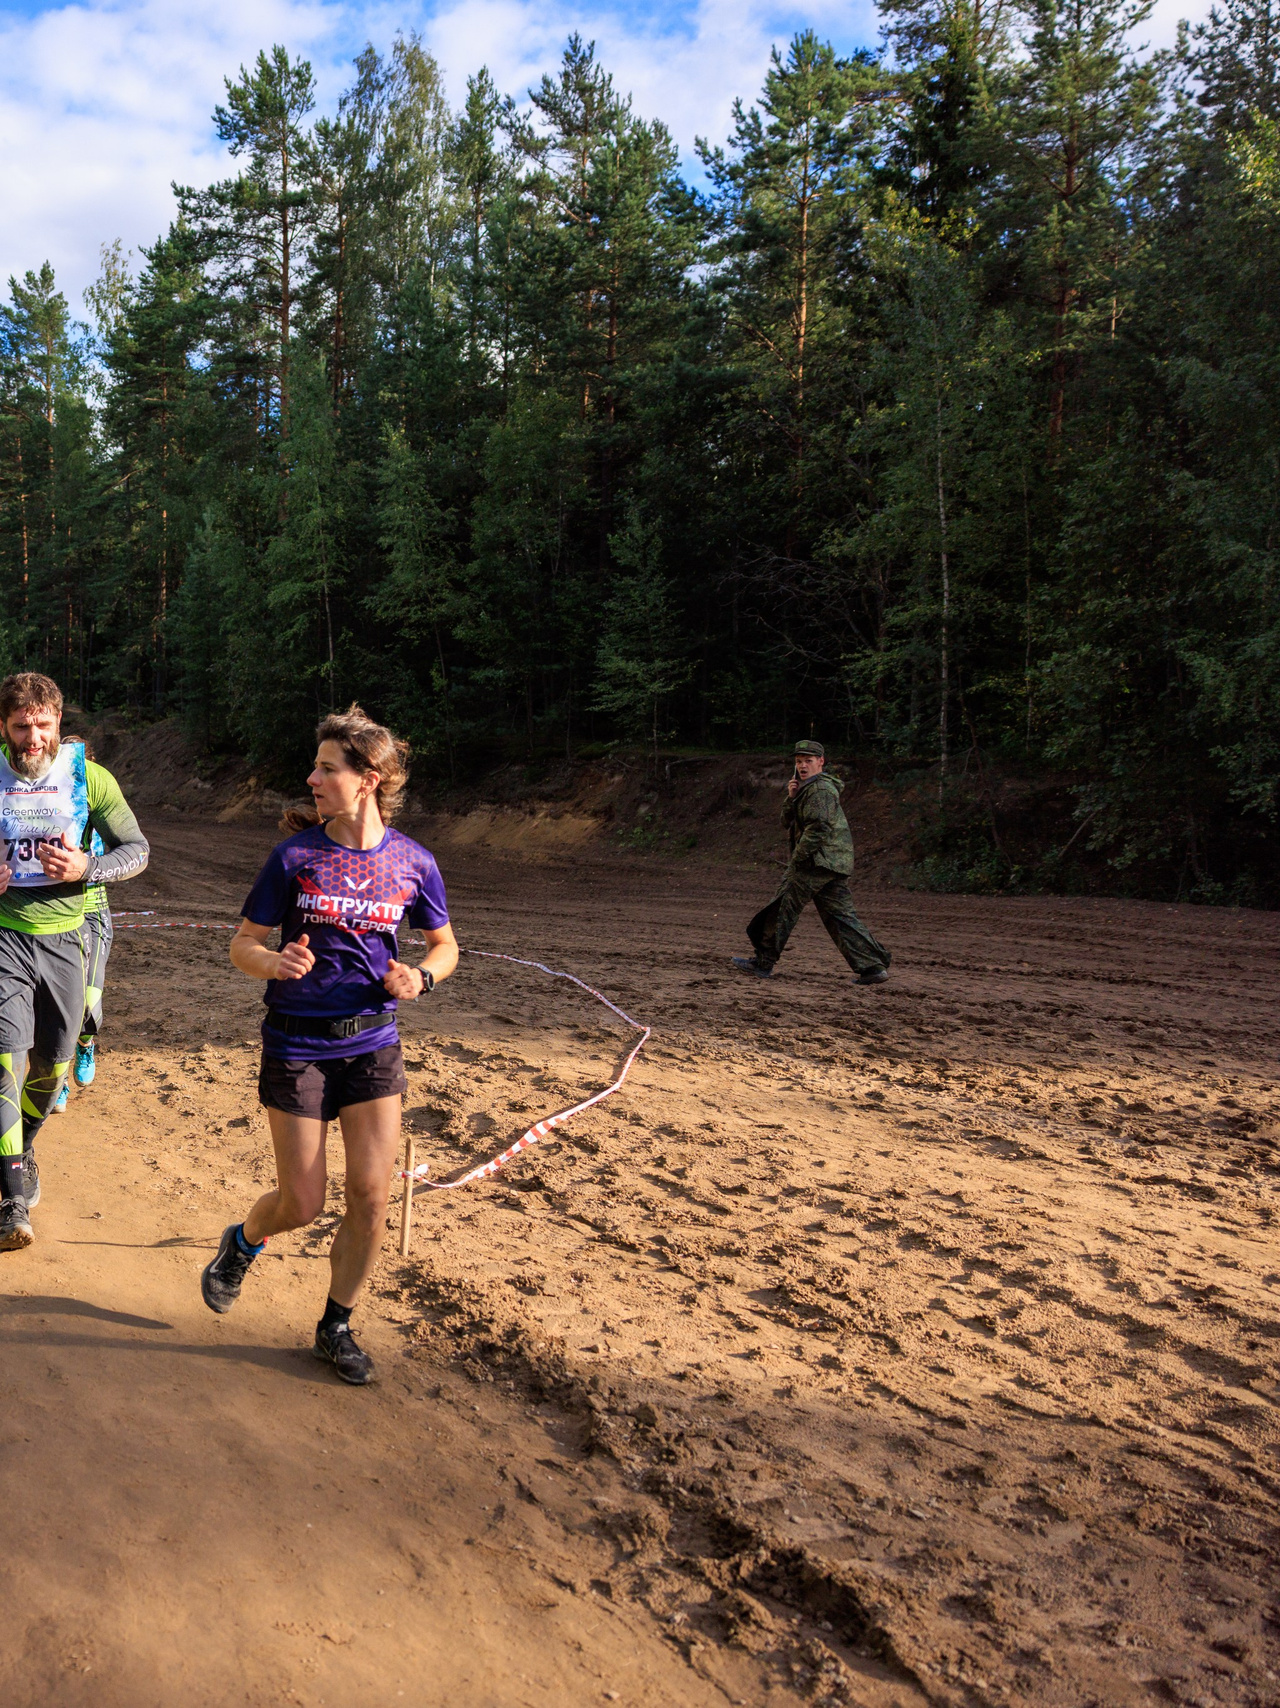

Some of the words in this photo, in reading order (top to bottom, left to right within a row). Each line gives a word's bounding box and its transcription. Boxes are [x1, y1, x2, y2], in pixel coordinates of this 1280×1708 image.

[2, 807, 55, 817] Greenway
[91, 857, 140, 881] Geenway
[303, 913, 348, 928] ГОНКА
